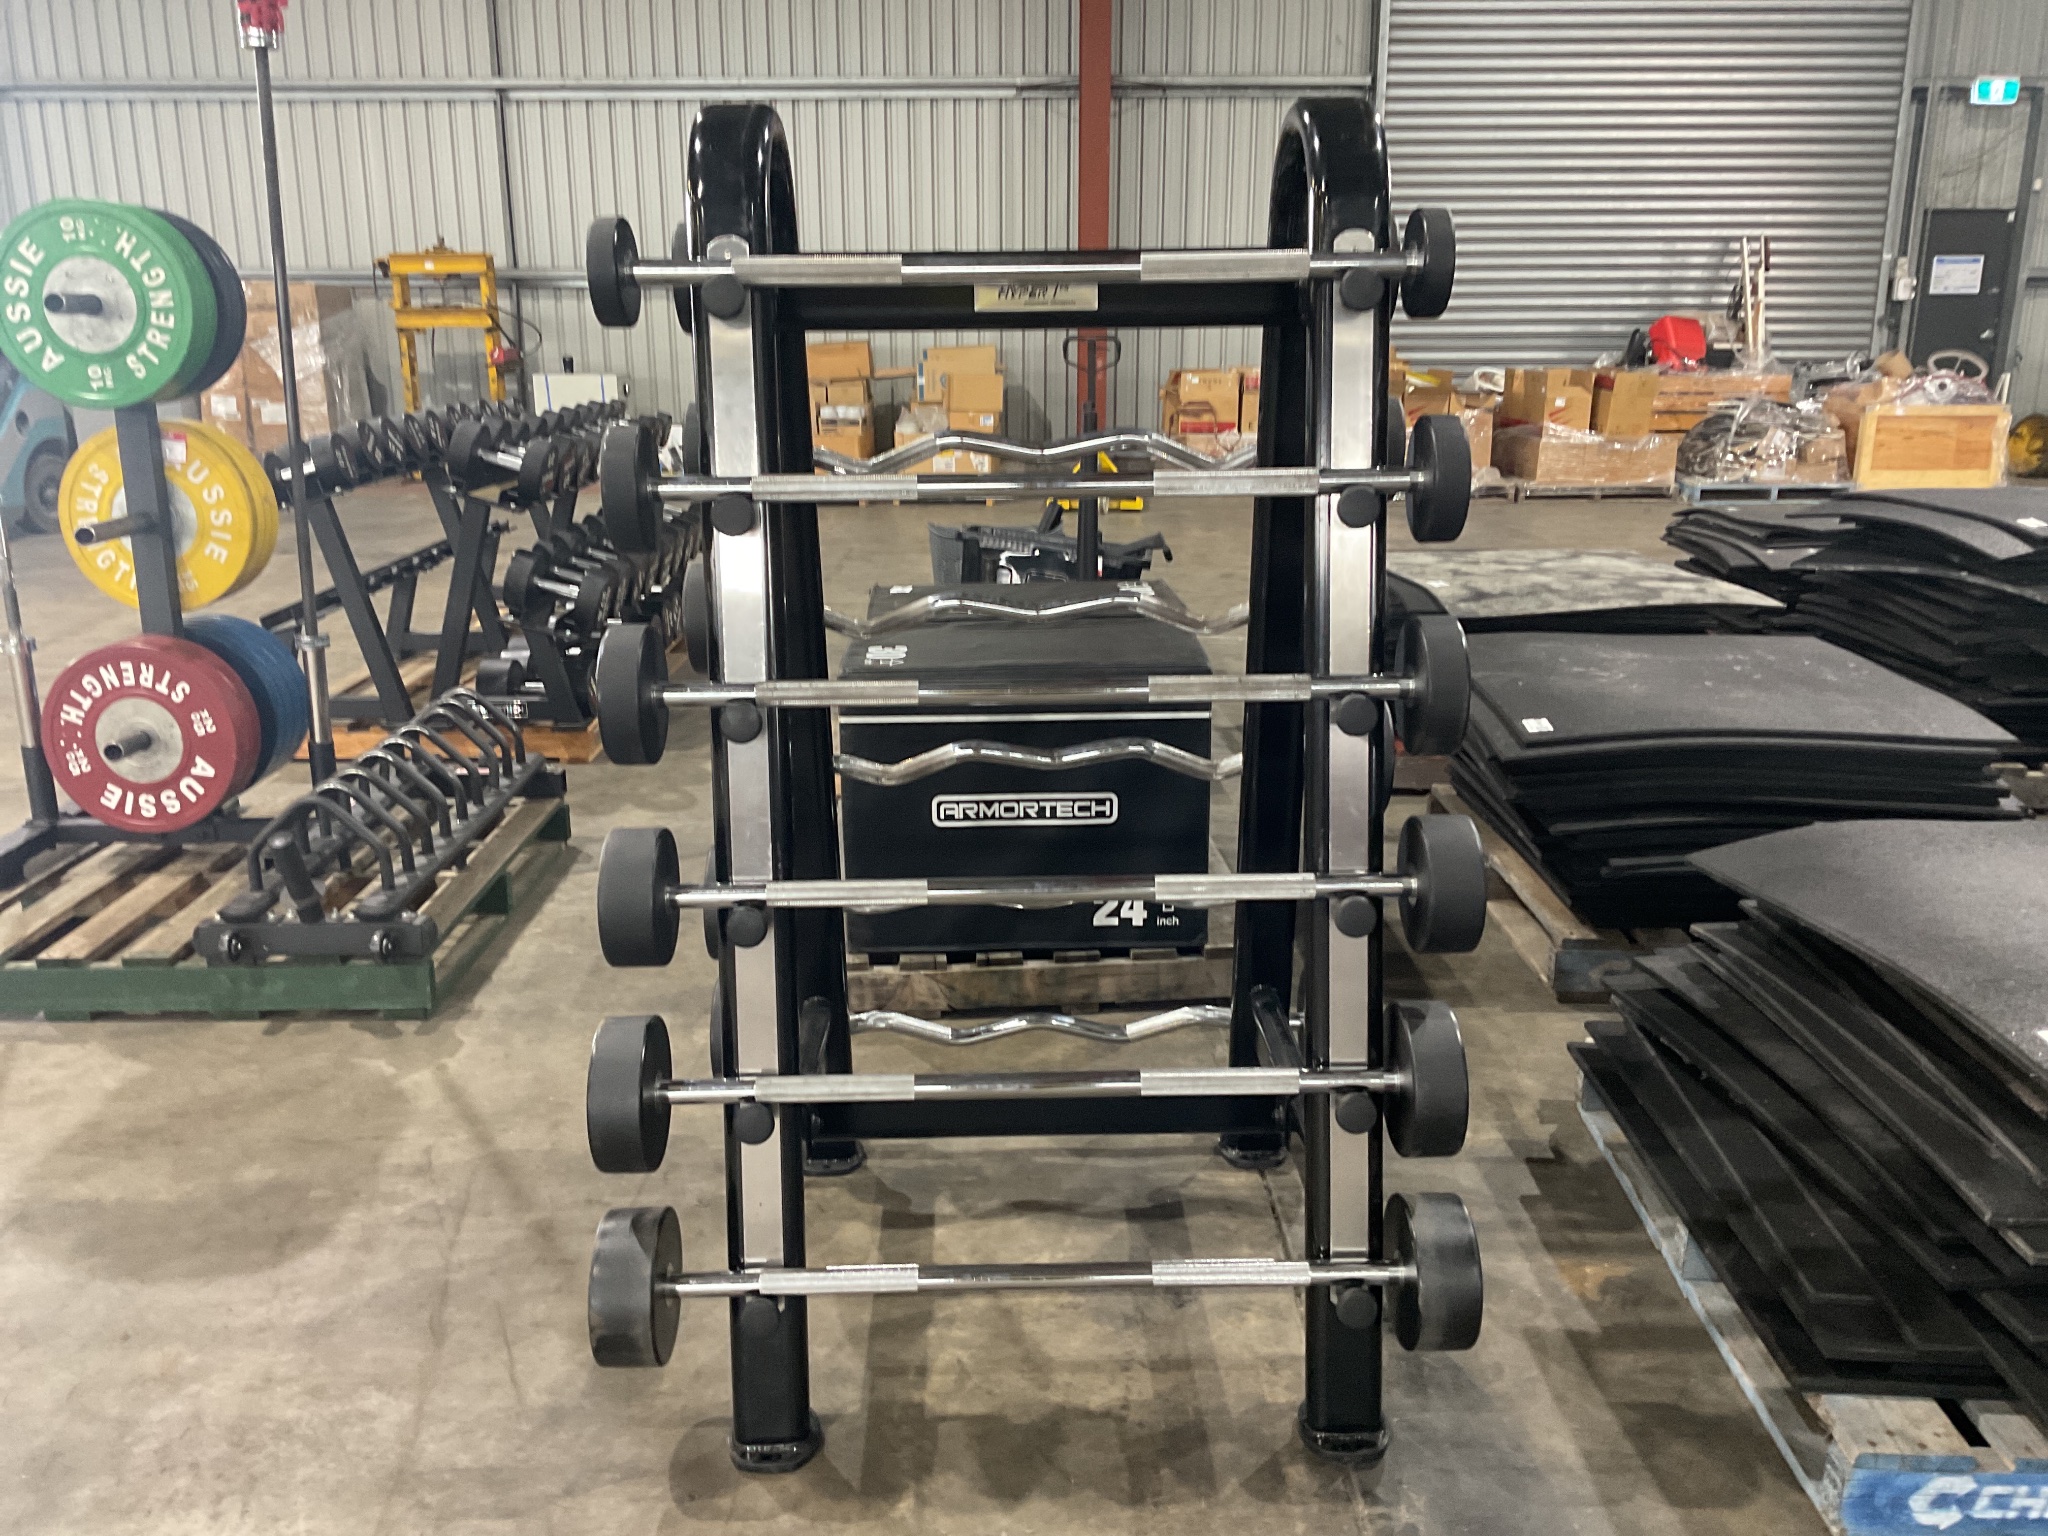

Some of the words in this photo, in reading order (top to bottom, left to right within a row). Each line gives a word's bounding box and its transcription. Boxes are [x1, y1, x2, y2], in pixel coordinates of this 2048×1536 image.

[60, 215, 76, 244] 10
[4, 236, 65, 373] AUSSIE
[114, 230, 175, 380] STRENGTH
[87, 363, 104, 391] 10
[175, 459, 233, 565] USSIE
[60, 661, 190, 726] STRENGTH
[100, 755, 215, 818] AUSSIE
[939, 799, 1111, 821] ARMORTECH
[1093, 899, 1148, 927] 24
[1156, 915, 1180, 927] inch
[1973, 1486, 2048, 1519] CH
